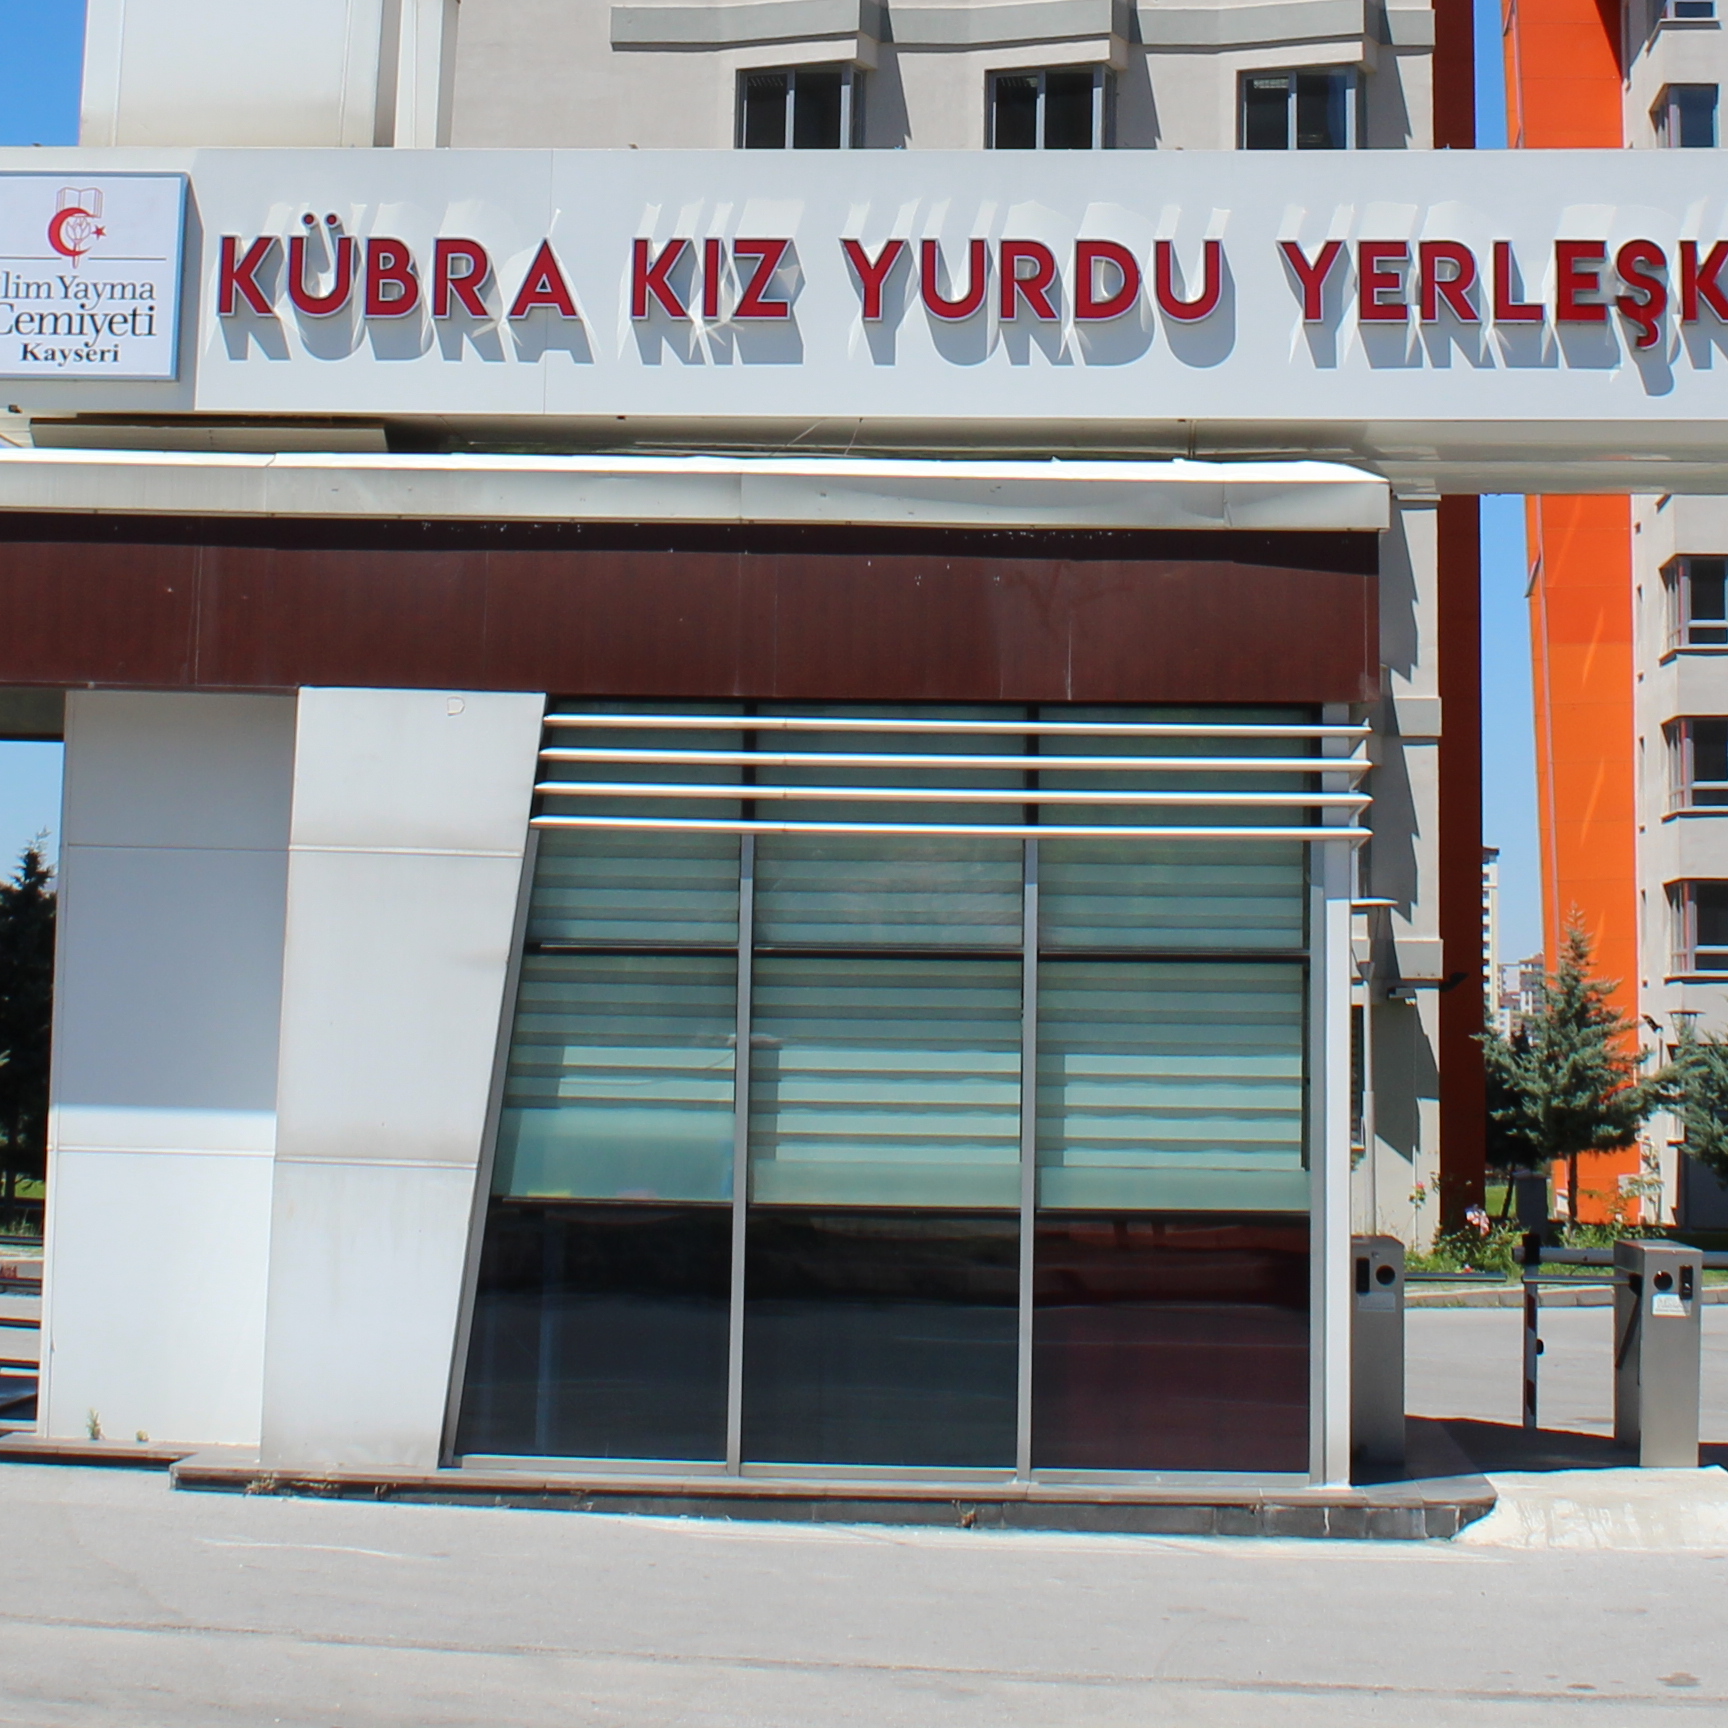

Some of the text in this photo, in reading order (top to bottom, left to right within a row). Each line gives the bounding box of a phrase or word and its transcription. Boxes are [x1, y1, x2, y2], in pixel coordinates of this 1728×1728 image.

[217, 211, 579, 320] KÜBRA
[630, 236, 792, 322] KIZ
[839, 236, 1222, 324] YURDU
[56, 274, 157, 311] Yayma
[19, 342, 120, 367] Kayseri
